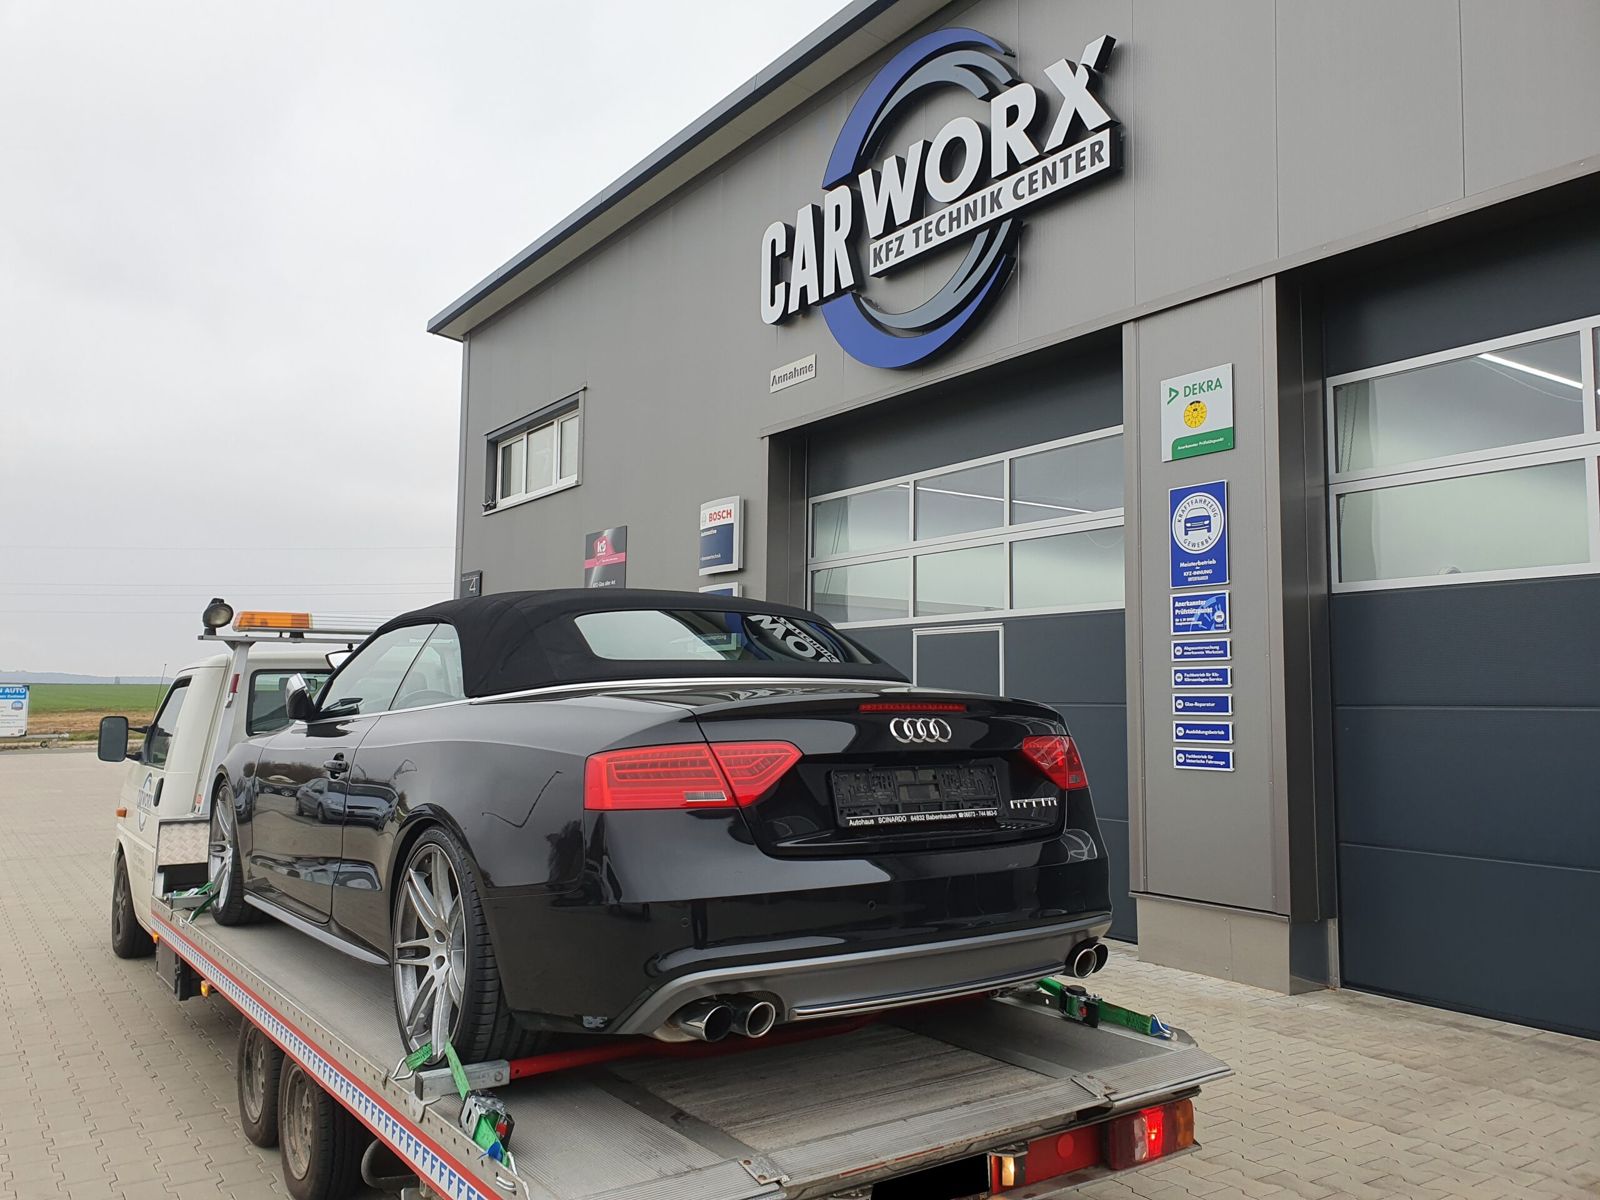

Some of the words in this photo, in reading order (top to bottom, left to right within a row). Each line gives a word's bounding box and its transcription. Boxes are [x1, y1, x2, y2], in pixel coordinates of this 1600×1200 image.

[872, 233, 905, 268] KFZ
[912, 186, 1003, 248] TECHNIK
[1012, 139, 1105, 201] CENTER
[771, 363, 814, 387] Annahme
[1183, 377, 1223, 398] DEKRA
[708, 508, 732, 523] BOSCH
[1177, 498, 1219, 523] KRAFTFAHRZEUG
[1183, 535, 1213, 548] GEWERBE
[469, 577, 476, 593] 4
[848, 819, 875, 827] Autohaus
[877, 815, 907, 824] SCINARDO
[925, 813, 958, 821] Babenhausen
